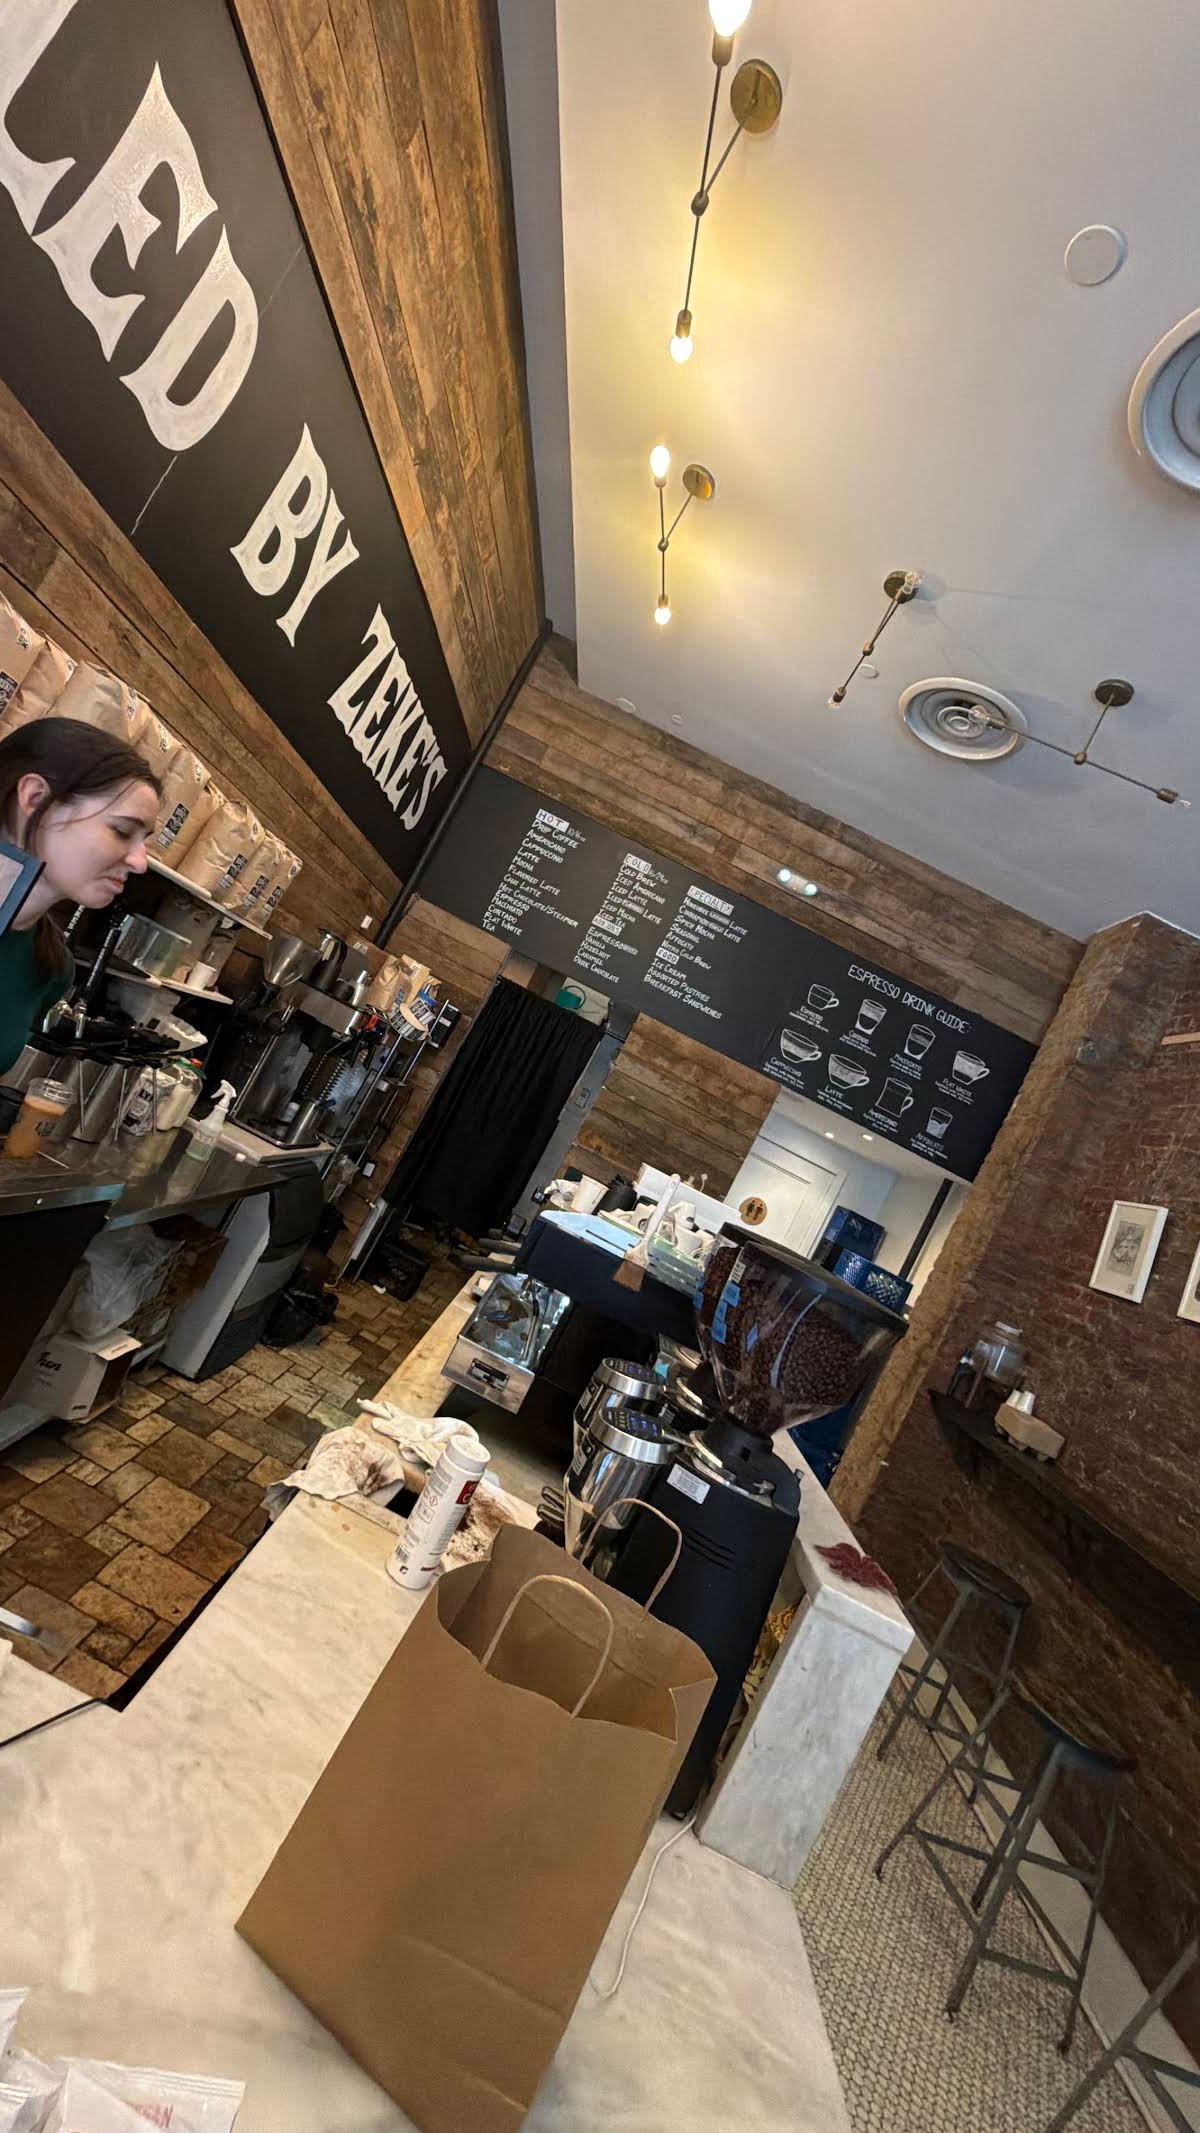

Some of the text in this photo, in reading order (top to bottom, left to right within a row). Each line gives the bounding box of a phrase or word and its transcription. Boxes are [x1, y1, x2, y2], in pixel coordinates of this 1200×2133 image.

[230, 422, 360, 648] BY
[326, 602, 449, 831] ZEKE'S
[538, 810, 567, 829] HOT
[526, 829, 566, 854] AMERICANO
[532, 819, 580, 848] DRIP COFFEE
[517, 847, 541, 863] LATTE
[521, 838, 564, 863] CAPPUCCINO
[512, 855, 535, 872] MOCHA
[620, 863, 657, 888] COLD BREW
[624, 854, 652, 874] COLD
[499, 882, 514, 894] HOT
[503, 873, 542, 897] CHAI LATTE
[508, 864, 560, 896] FLAVORED LATTE
[616, 872, 666, 905] ICED AMERICANO
[495, 889, 530, 911] ESPRESSO
[611, 881, 649, 906] ICED LATTE
[687, 885, 734, 915] SPECIALTY
[488, 904, 518, 924] CORTADO
[597, 908, 626, 929] ICED TEA
[601, 899, 636, 923] ICED MOCHA
[606, 890, 622, 905] ICED
[643, 909, 663, 925] LATTE
[482, 918, 496, 932] TEA
[483, 911, 524, 936] FLAT WHITE
[670, 923, 700, 944] SEASONAL
[679, 905, 710, 926] CINNAMON
[723, 929, 742, 943] LATTE
[694, 924, 716, 940] MOCHA
[729, 921, 748, 935] LATTE
[580, 940, 611, 960] HAZELNUT
[585, 934, 606, 949] VANILLA
[587, 926, 624, 950] ESPRESSO
[577, 948, 604, 966] CARAMEL
[657, 948, 680, 964] FOOD
[661, 940, 712, 970] NITRO COLD BREW
[573, 955, 620, 983] DARK CHOCOLATE
[651, 957, 687, 980] ICE CREAM
[647, 966, 711, 1002] ASSORTED PASTRIES
[847, 964, 900, 999] ESPRESSO
[901, 991, 936, 1017] DRINK
[644, 973, 722, 1020] BREAKFAST SANDWICHES
[824, 1084, 844, 1100] LATTE
